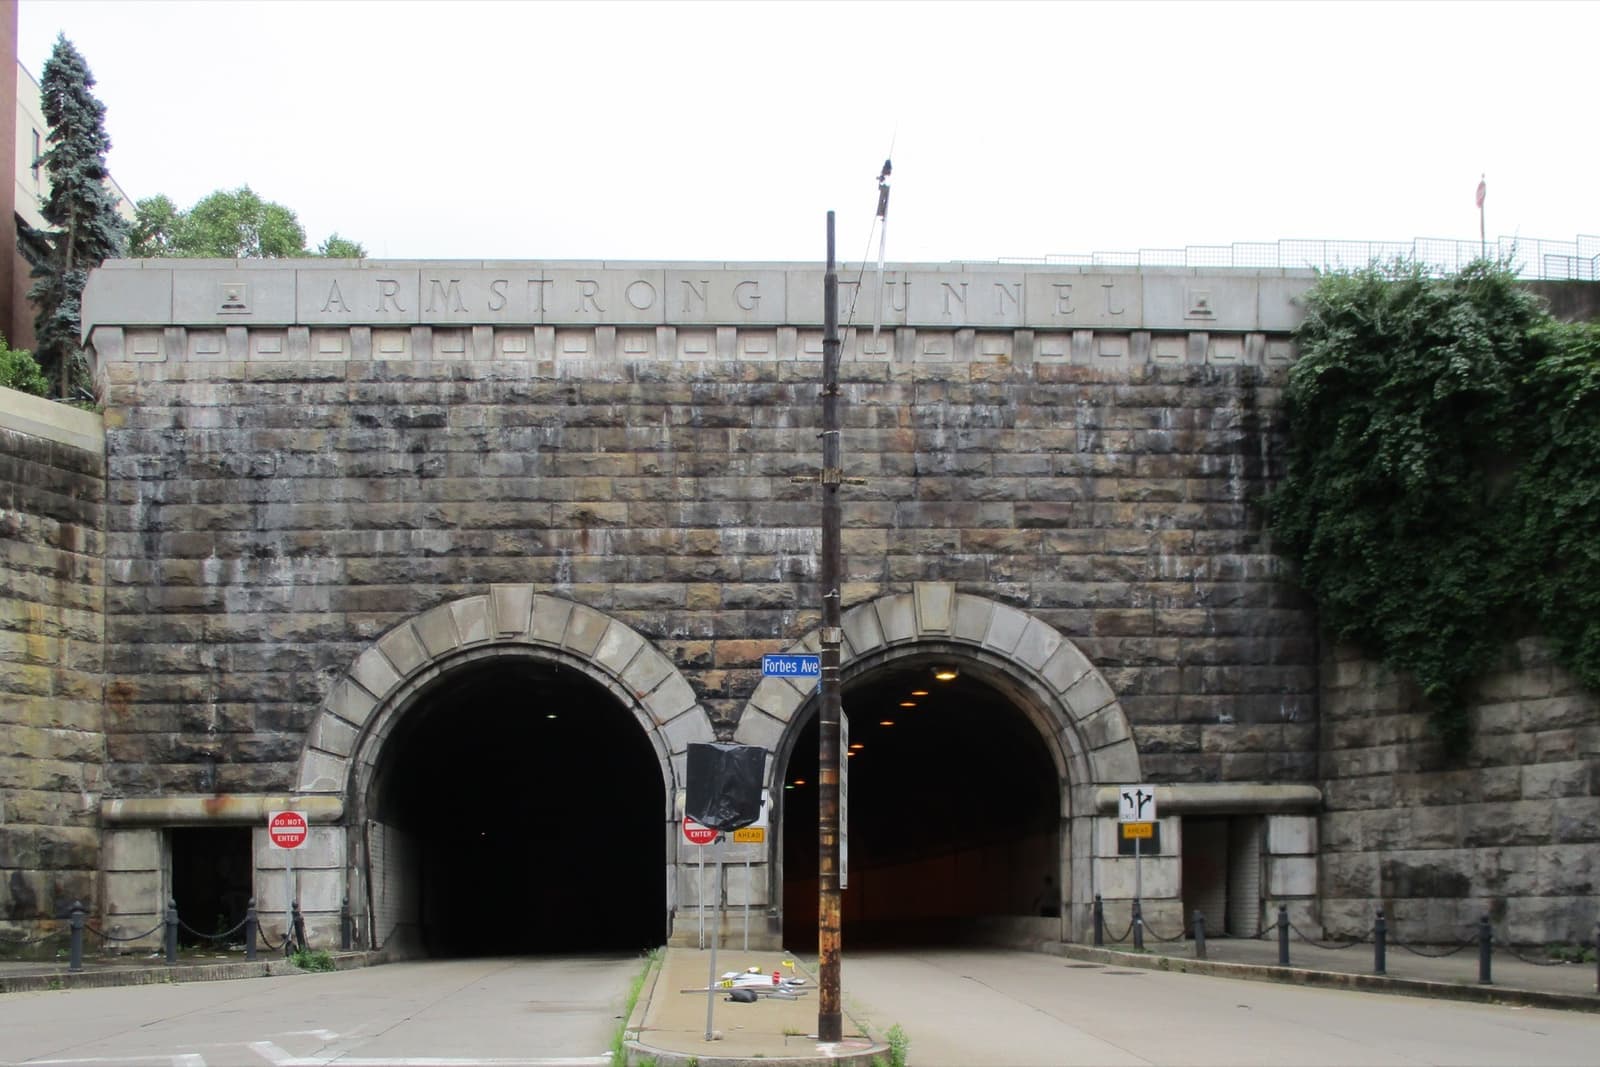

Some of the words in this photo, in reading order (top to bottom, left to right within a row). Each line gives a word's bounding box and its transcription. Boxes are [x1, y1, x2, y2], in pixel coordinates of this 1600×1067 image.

[320, 279, 761, 312] ARMSTRONG
[837, 281, 1125, 316] TUNNEL
[765, 659, 797, 673] Forbes
[801, 659, 818, 673] Ave
[274, 818, 285, 826] DO
[287, 818, 302, 826] NOT
[277, 834, 299, 842] ENTER
[690, 830, 713, 838] ENTER
